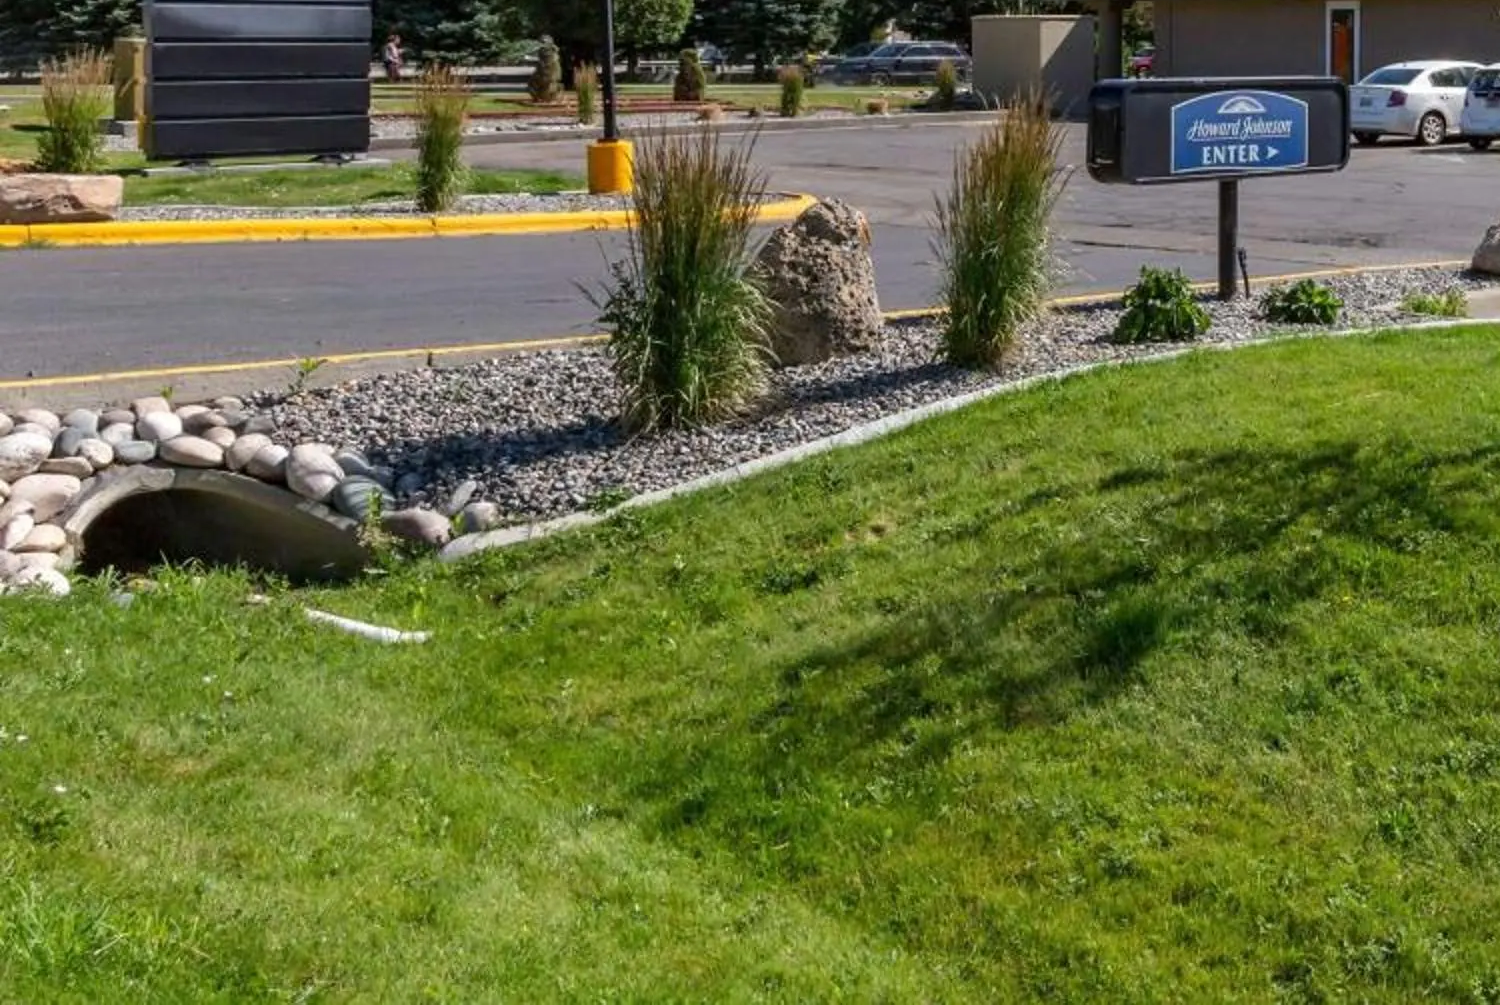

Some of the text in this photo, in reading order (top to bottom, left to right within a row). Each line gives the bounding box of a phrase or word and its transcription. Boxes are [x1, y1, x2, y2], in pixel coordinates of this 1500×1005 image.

[1187, 116, 1293, 141] Howard Johnson
[1202, 145, 1260, 165] ENTER
